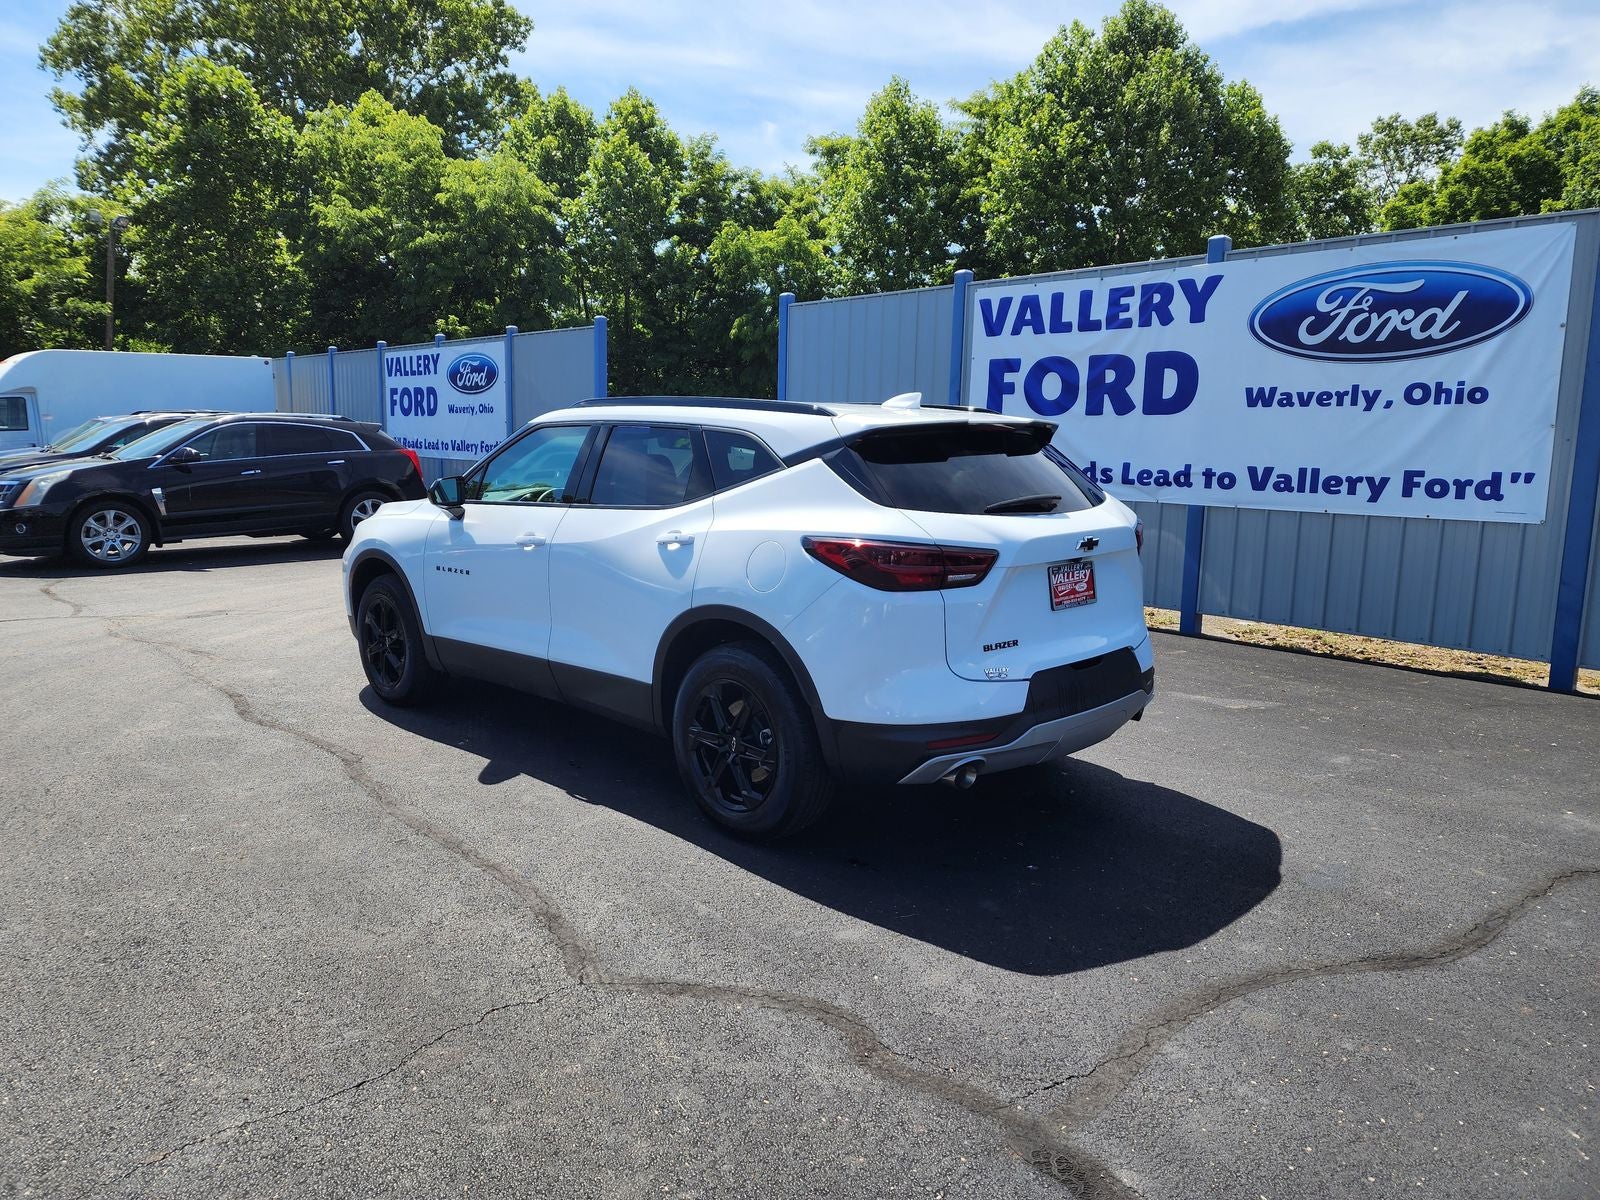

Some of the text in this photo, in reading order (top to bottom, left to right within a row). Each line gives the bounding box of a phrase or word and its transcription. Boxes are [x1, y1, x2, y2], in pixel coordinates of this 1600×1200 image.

[978, 274, 1225, 338] VALLERY
[1298, 278, 1470, 347] Ford
[385, 353, 441, 377] VALLERY
[456, 360, 488, 387] Ford
[987, 349, 1200, 416] FORD
[390, 387, 438, 416] FORD
[447, 403, 494, 416] Waverly, Ohio
[1244, 381, 1490, 413] Waverly, Ohio
[402, 437, 423, 450] Roads
[424, 438, 440, 451] Lead
[441, 440, 449, 451] to
[450, 440, 479, 455] Vallery
[1121, 462, 1193, 489] Lead
[1203, 466, 1238, 491] to
[1247, 465, 1391, 504] Vallery
[436, 565, 470, 575] BLAZER
[1052, 568, 1091, 585] VALLERY
[983, 639, 1019, 652] BLAZER
